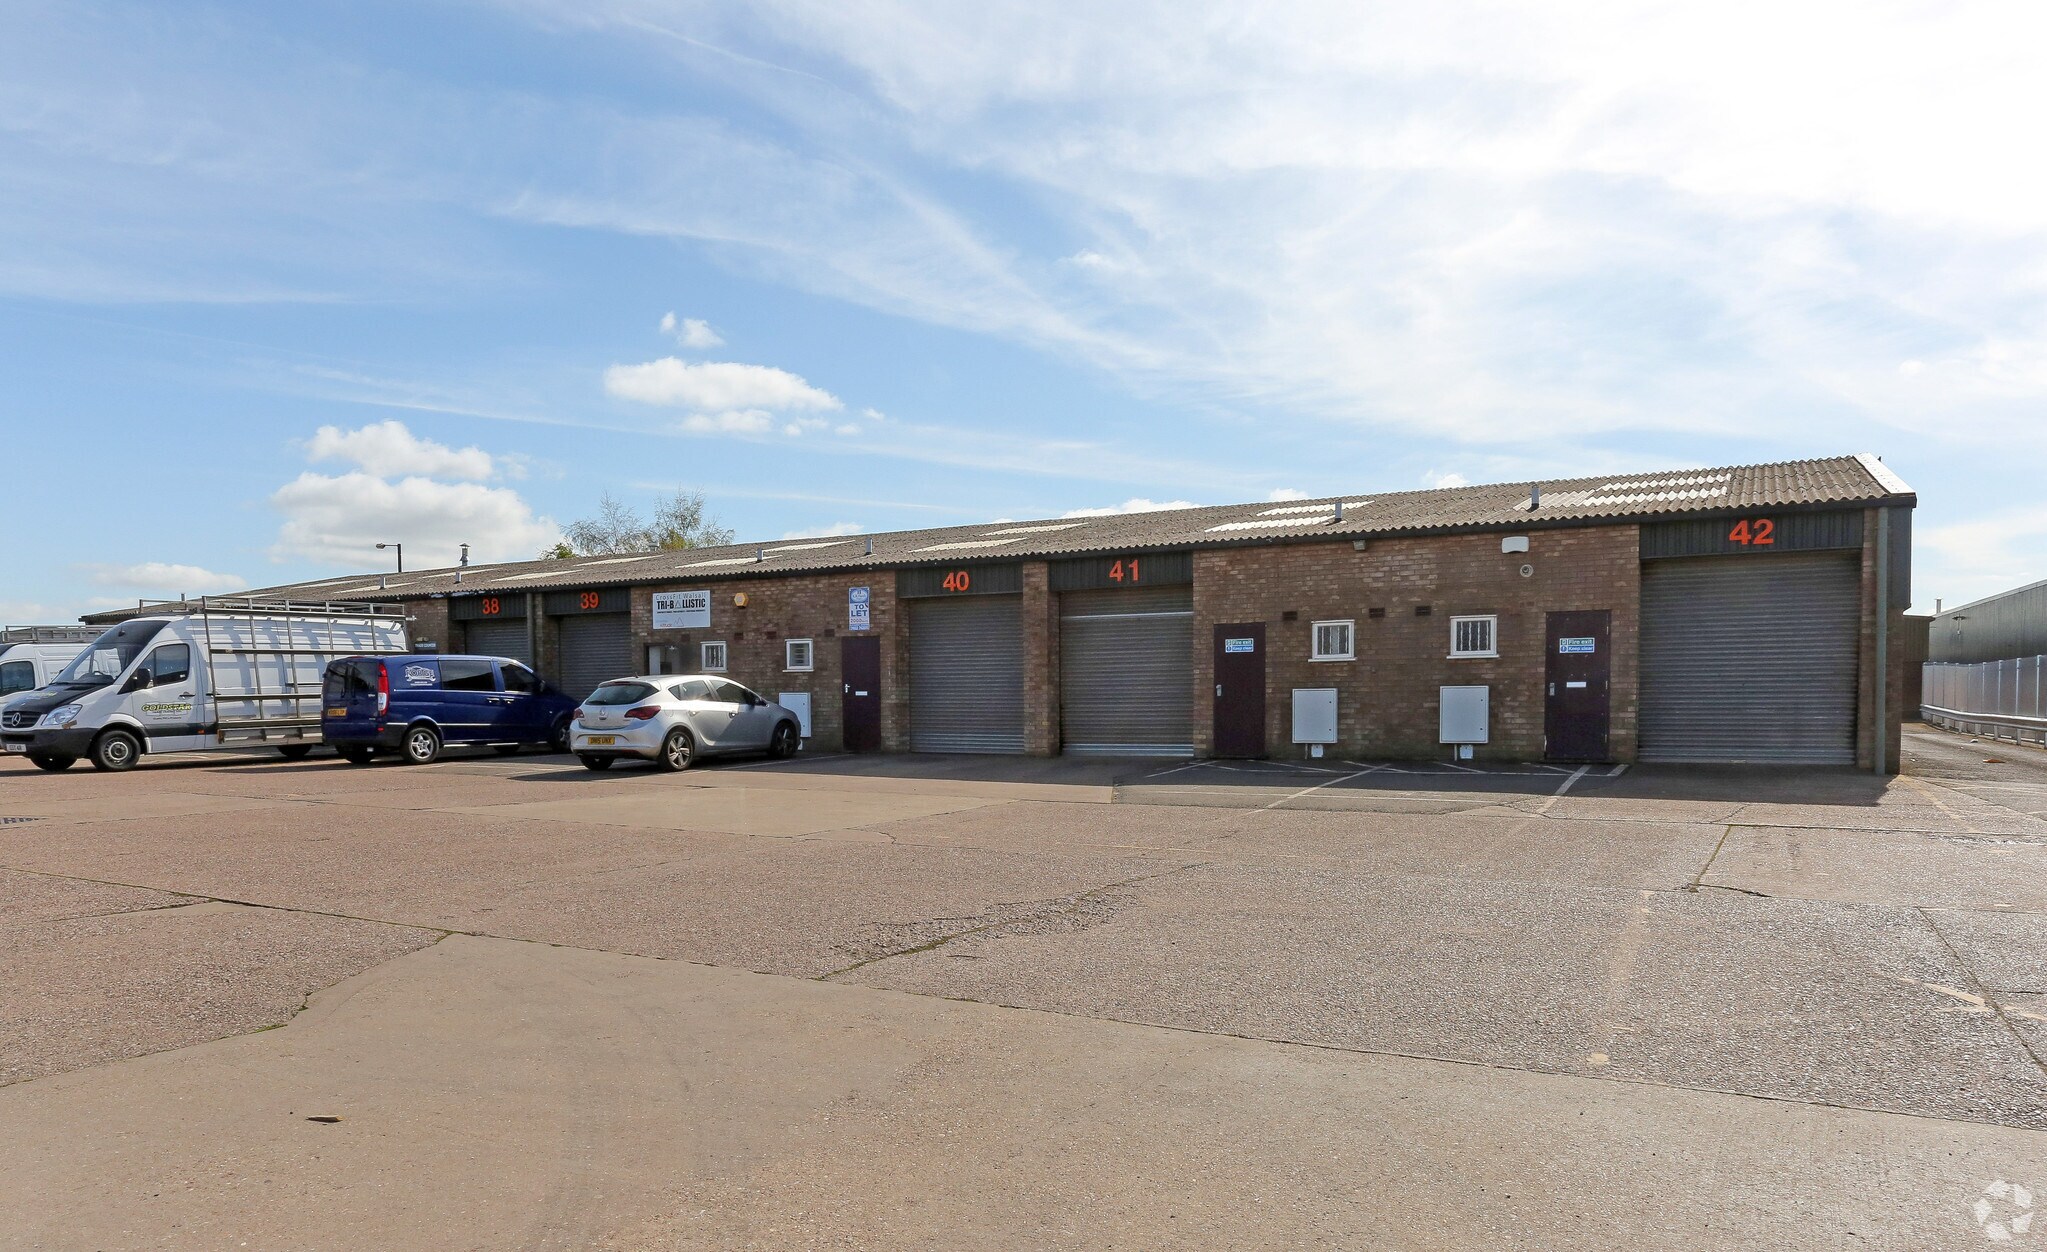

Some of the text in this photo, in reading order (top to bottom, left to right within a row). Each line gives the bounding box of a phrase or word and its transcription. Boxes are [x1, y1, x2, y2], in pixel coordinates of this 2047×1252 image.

[1729, 518, 1774, 545] 42
[1109, 559, 1140, 582] 41
[942, 571, 970, 592] 40
[580, 592, 599, 609] 39
[655, 593, 682, 601] CrossFit
[482, 598, 499, 614] 38
[851, 609, 868, 617] LET
[141, 703, 192, 712] GOLDSTAR
